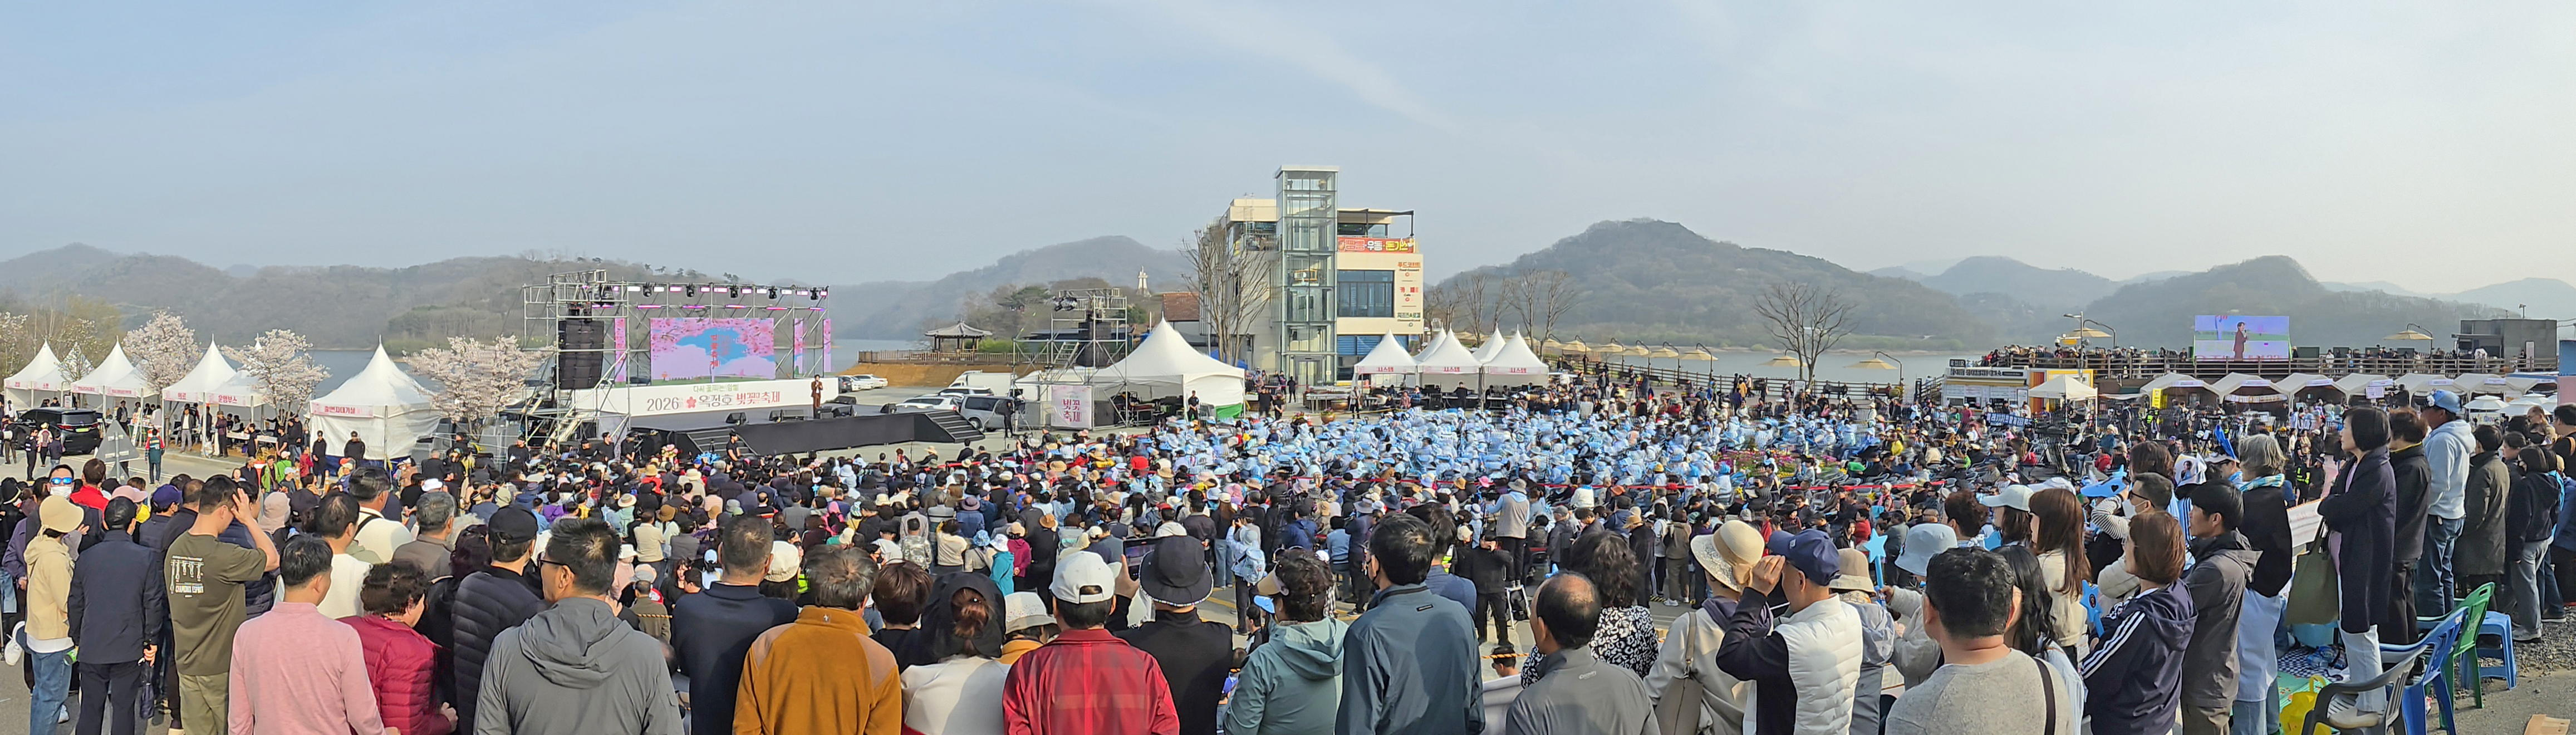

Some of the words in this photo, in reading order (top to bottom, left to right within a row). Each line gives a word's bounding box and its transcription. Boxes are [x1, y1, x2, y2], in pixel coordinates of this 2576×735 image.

[218, 395, 237, 404] 운영부스
[647, 397, 679, 411] 2026
[699, 394, 732, 407] 옥정호
[1063, 399, 1080, 410] 벚꽃
[1063, 410, 1081, 422] 축제
